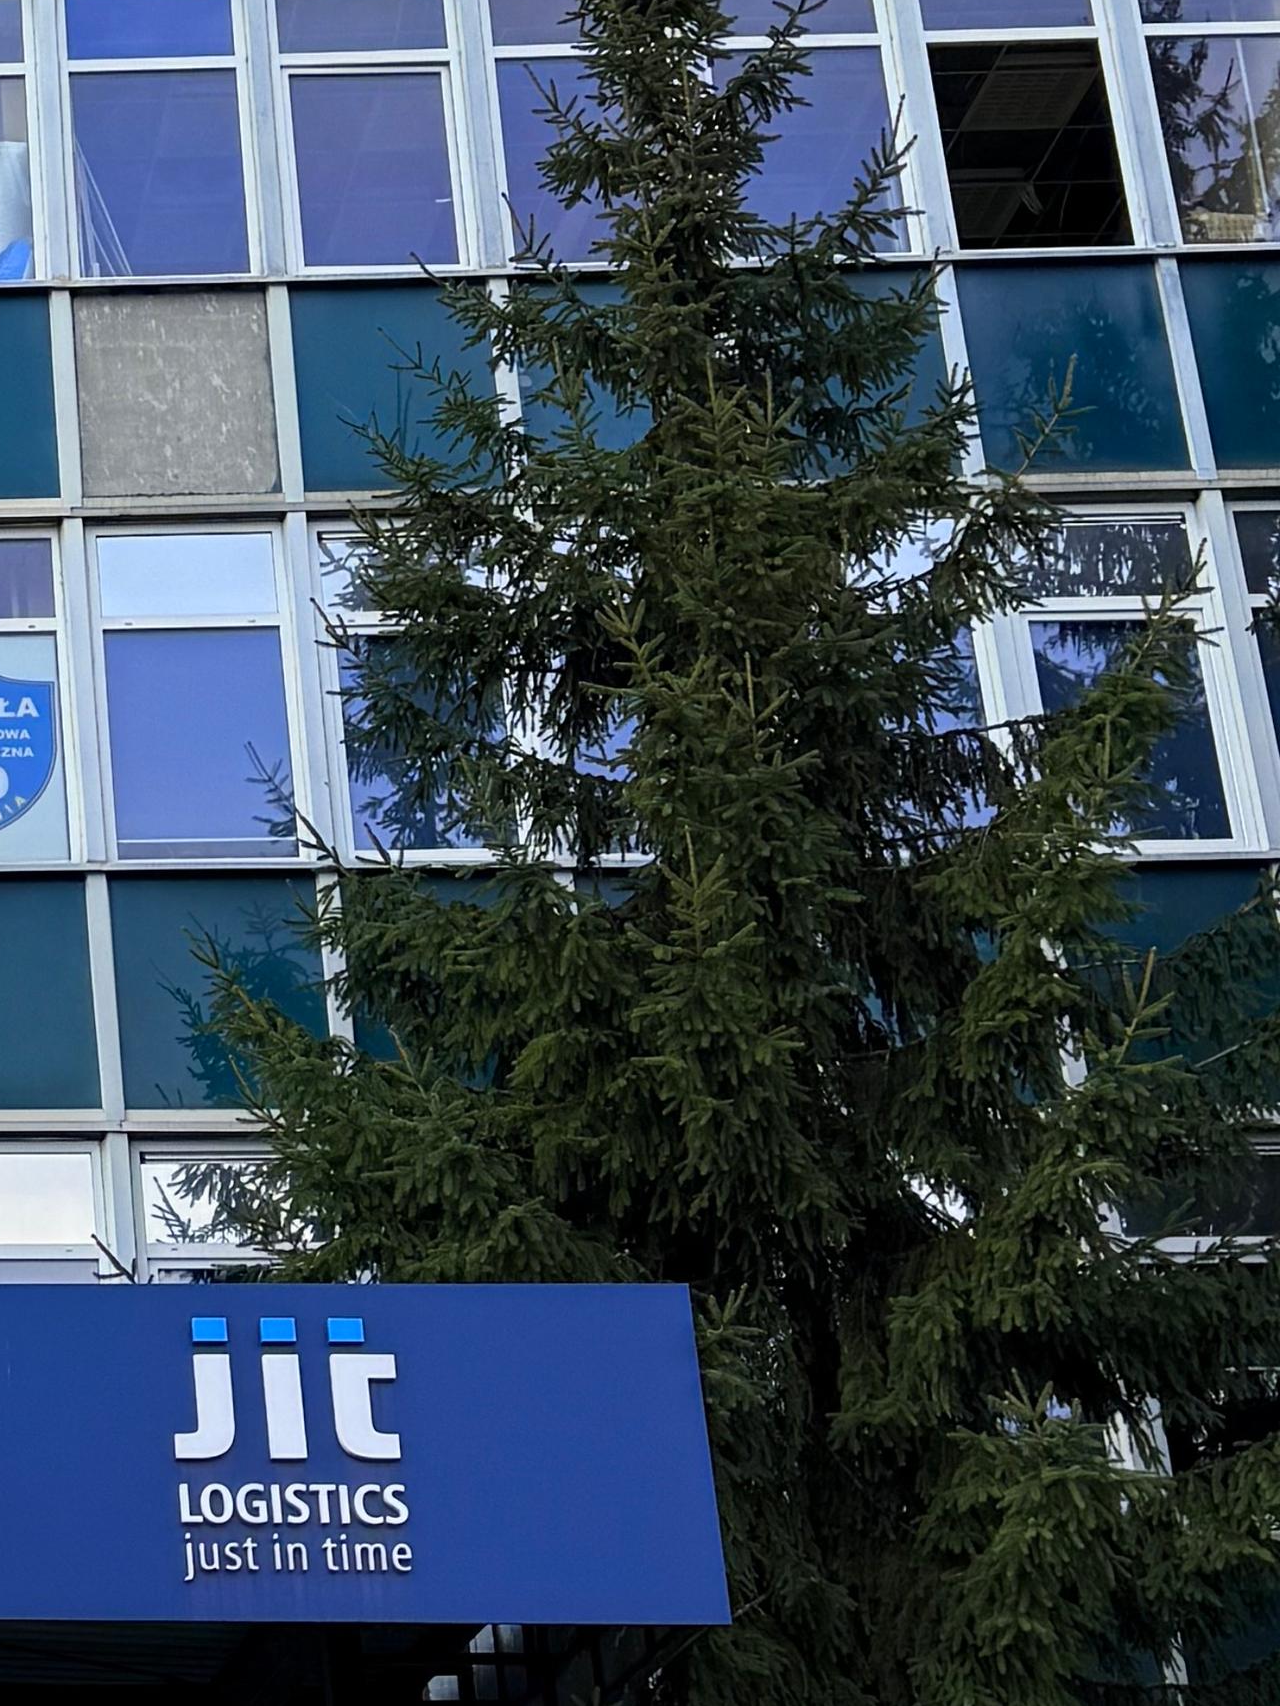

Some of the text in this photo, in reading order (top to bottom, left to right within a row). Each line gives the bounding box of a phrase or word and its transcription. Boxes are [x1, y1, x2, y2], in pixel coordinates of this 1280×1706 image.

[179, 1483, 409, 1524] LOGISTICS
[184, 1533, 412, 1581] just in time
